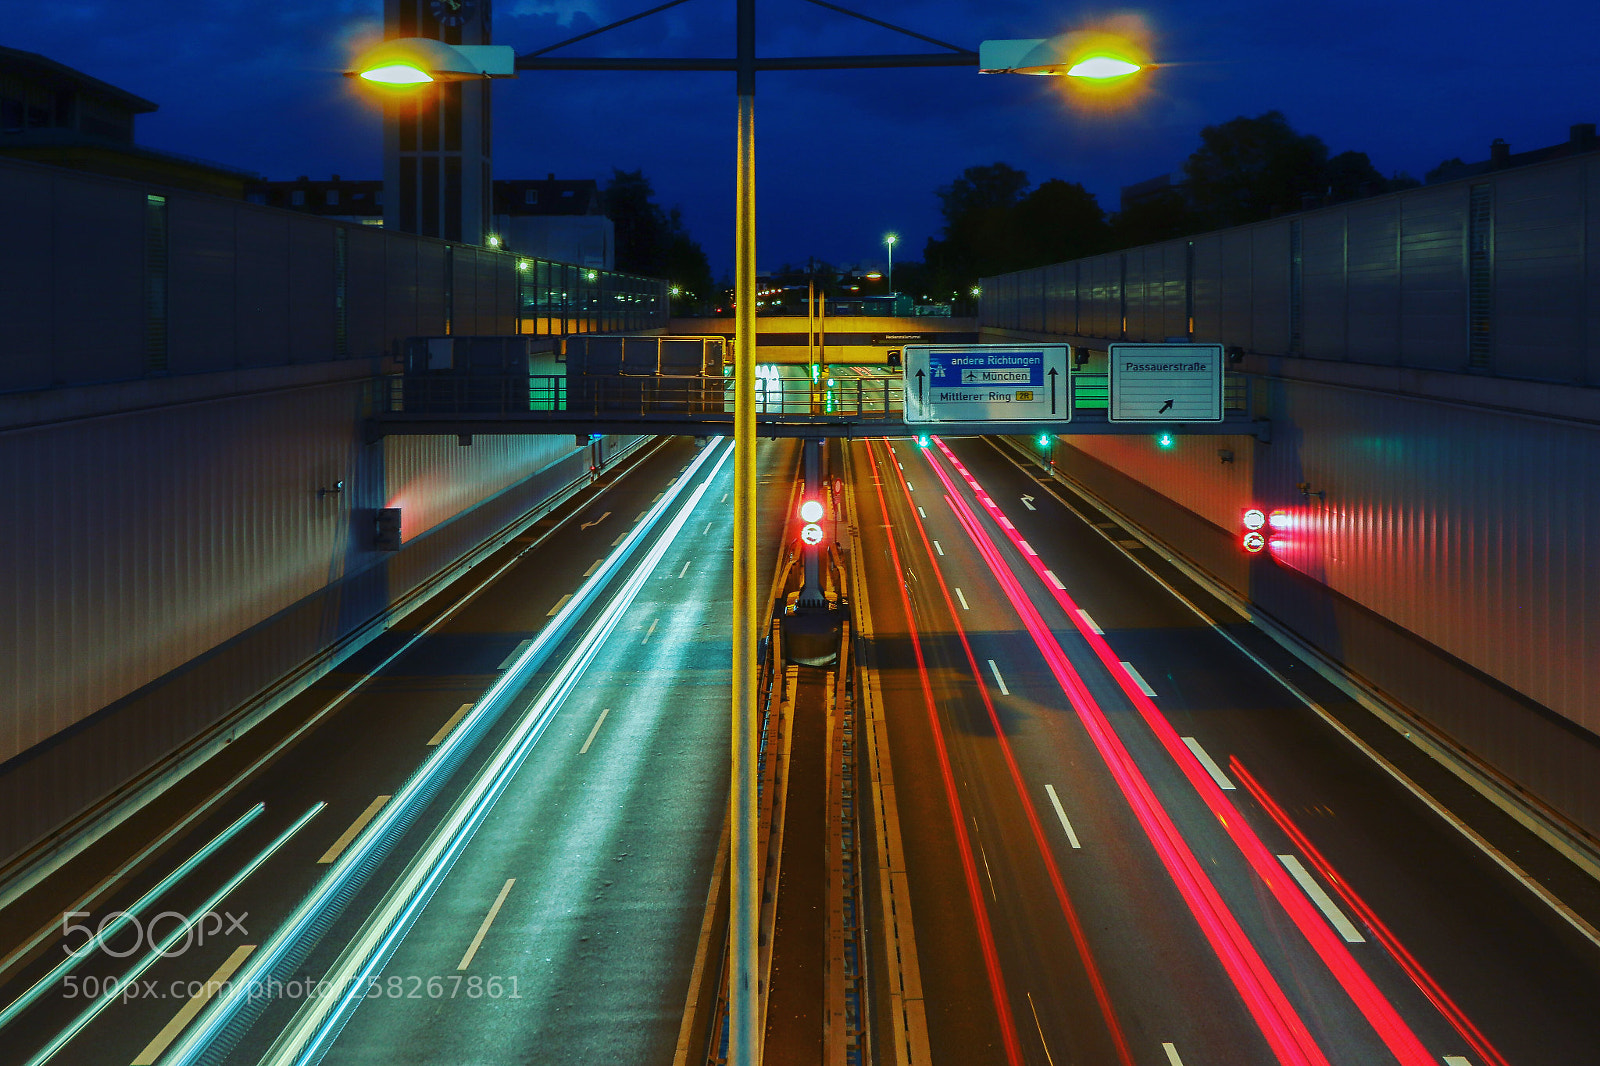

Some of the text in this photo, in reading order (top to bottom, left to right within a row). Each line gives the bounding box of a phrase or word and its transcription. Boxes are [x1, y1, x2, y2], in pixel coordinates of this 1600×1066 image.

[951, 355, 1040, 367] andere Richtungen
[1126, 362, 1206, 371] Passauerstraße
[982, 371, 1028, 381] München
[940, 391, 1030, 402] Mittlerer Ring 2R
